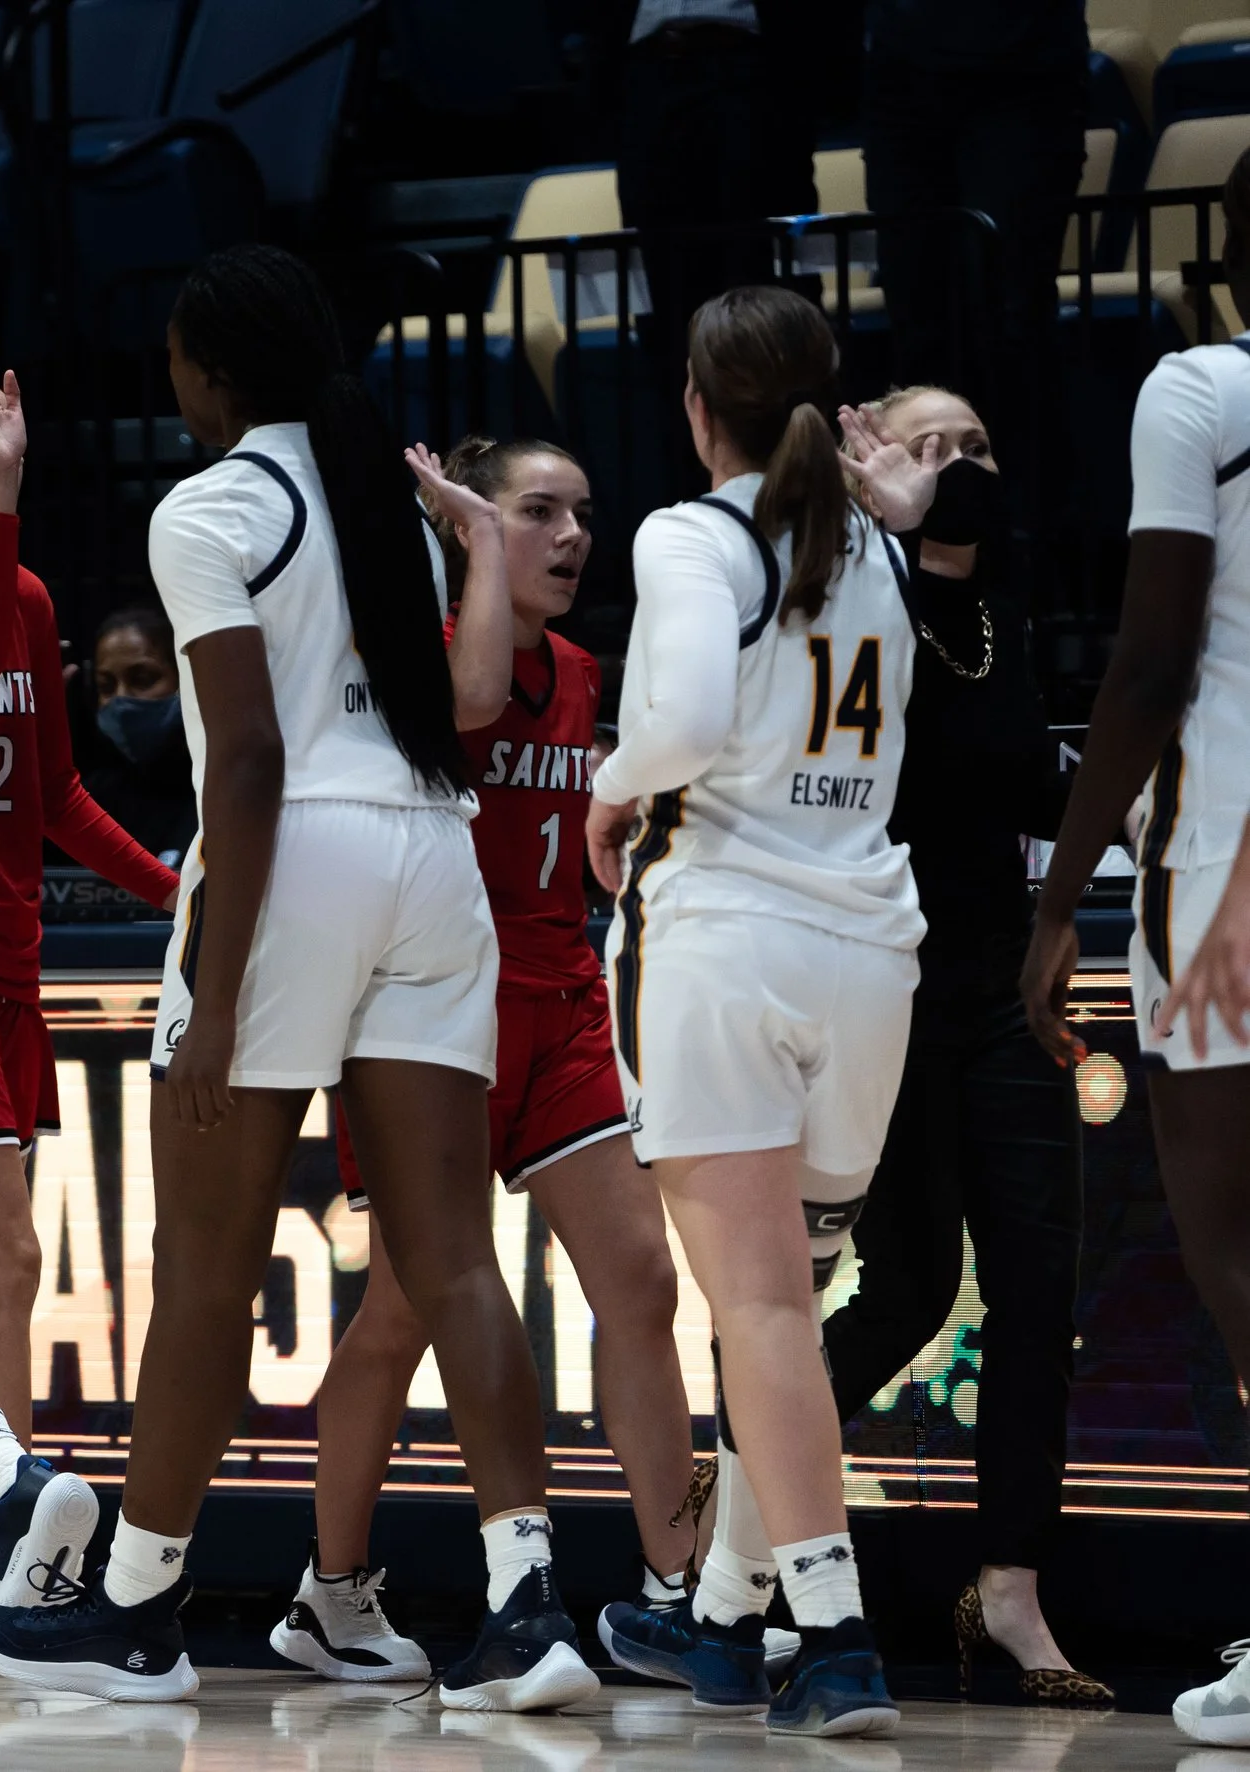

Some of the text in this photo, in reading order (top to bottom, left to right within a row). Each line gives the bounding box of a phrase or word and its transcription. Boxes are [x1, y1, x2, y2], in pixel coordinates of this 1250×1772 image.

[804, 634, 883, 759] 14
[790, 772, 874, 810] ELSNITZ
[538, 812, 560, 889] 1
